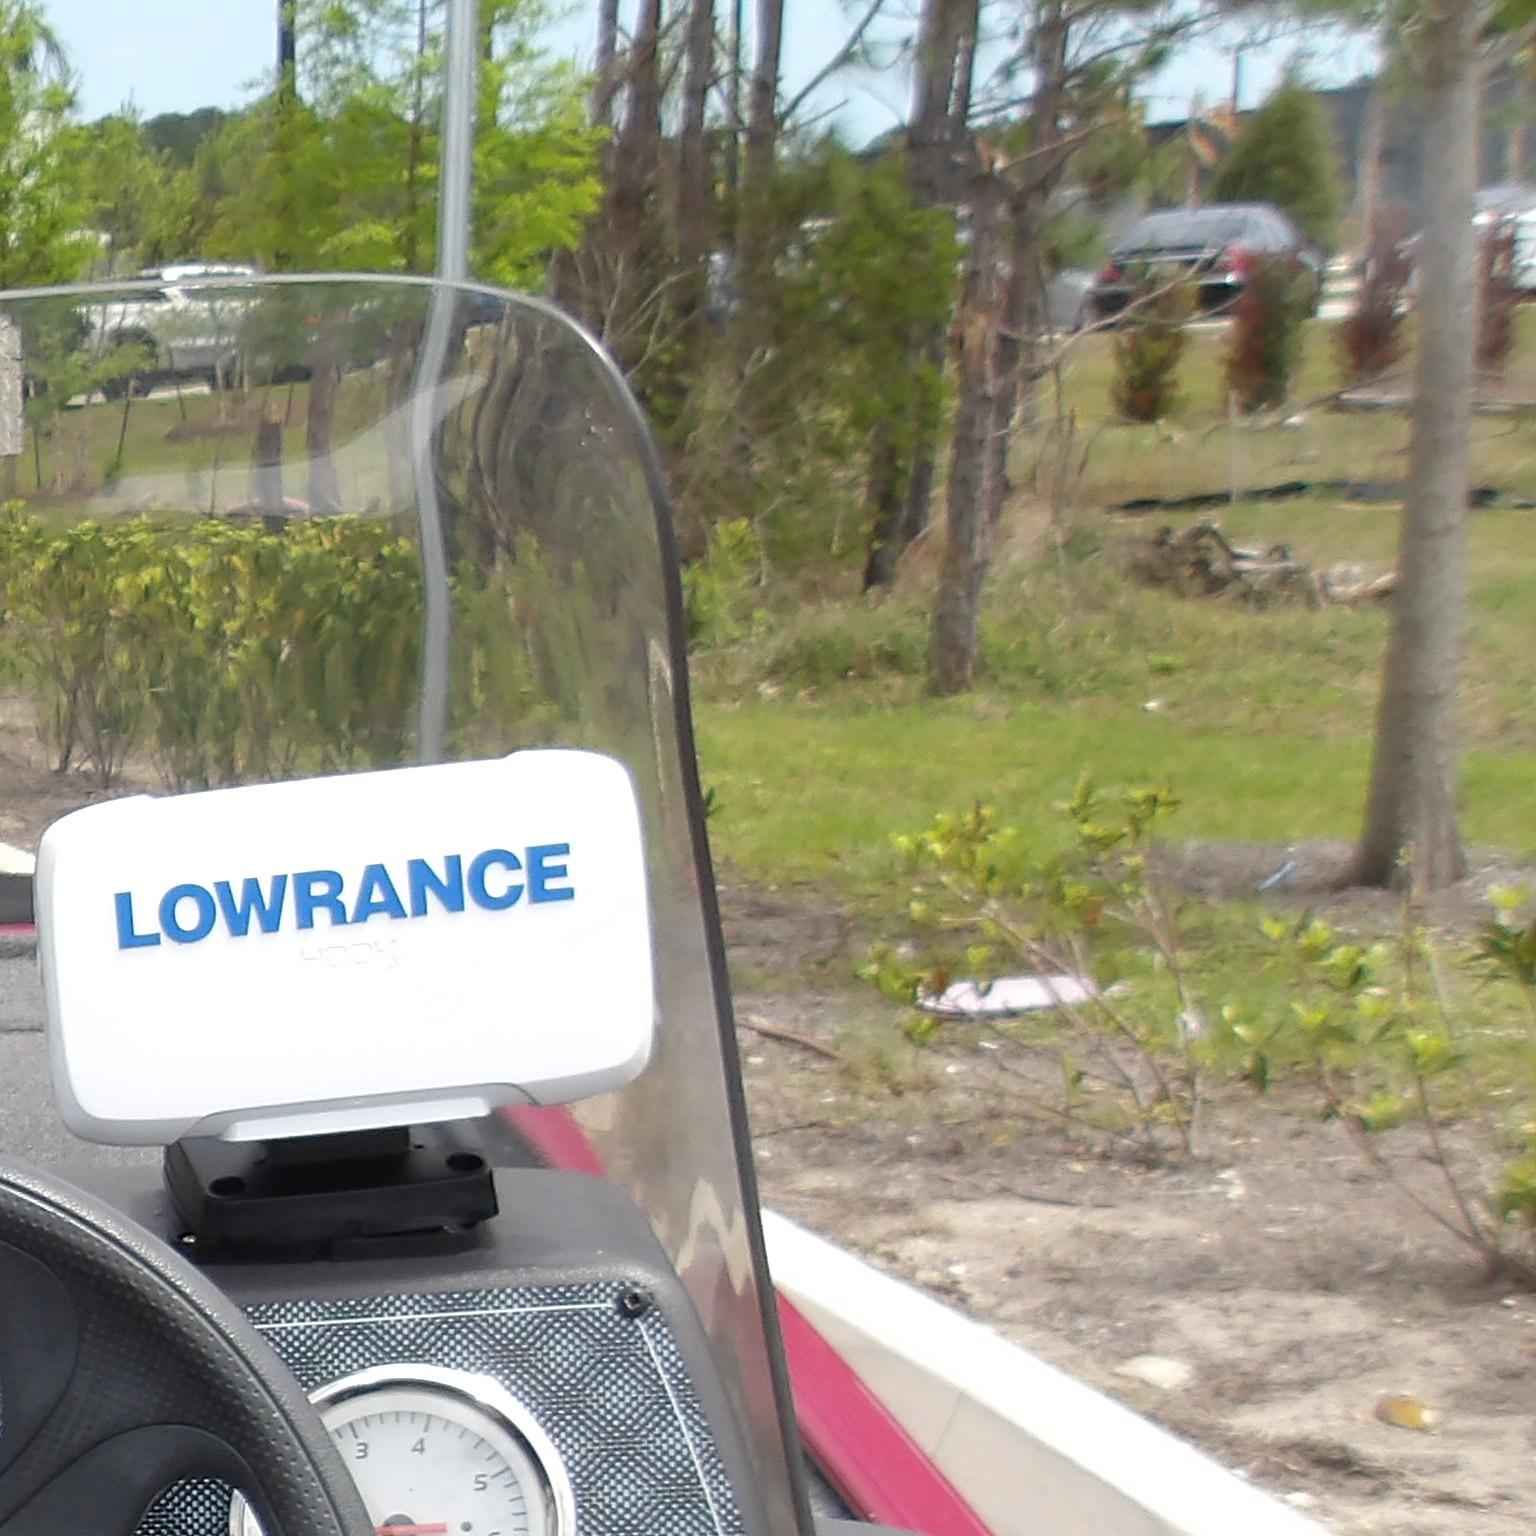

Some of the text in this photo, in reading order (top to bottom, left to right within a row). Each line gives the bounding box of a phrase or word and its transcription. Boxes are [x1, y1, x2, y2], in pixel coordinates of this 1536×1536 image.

[115, 843, 575, 949] LOWRANCE
[355, 1442, 369, 1460] 3
[410, 1438, 426, 1455] 4
[473, 1473, 489, 1492] 5
